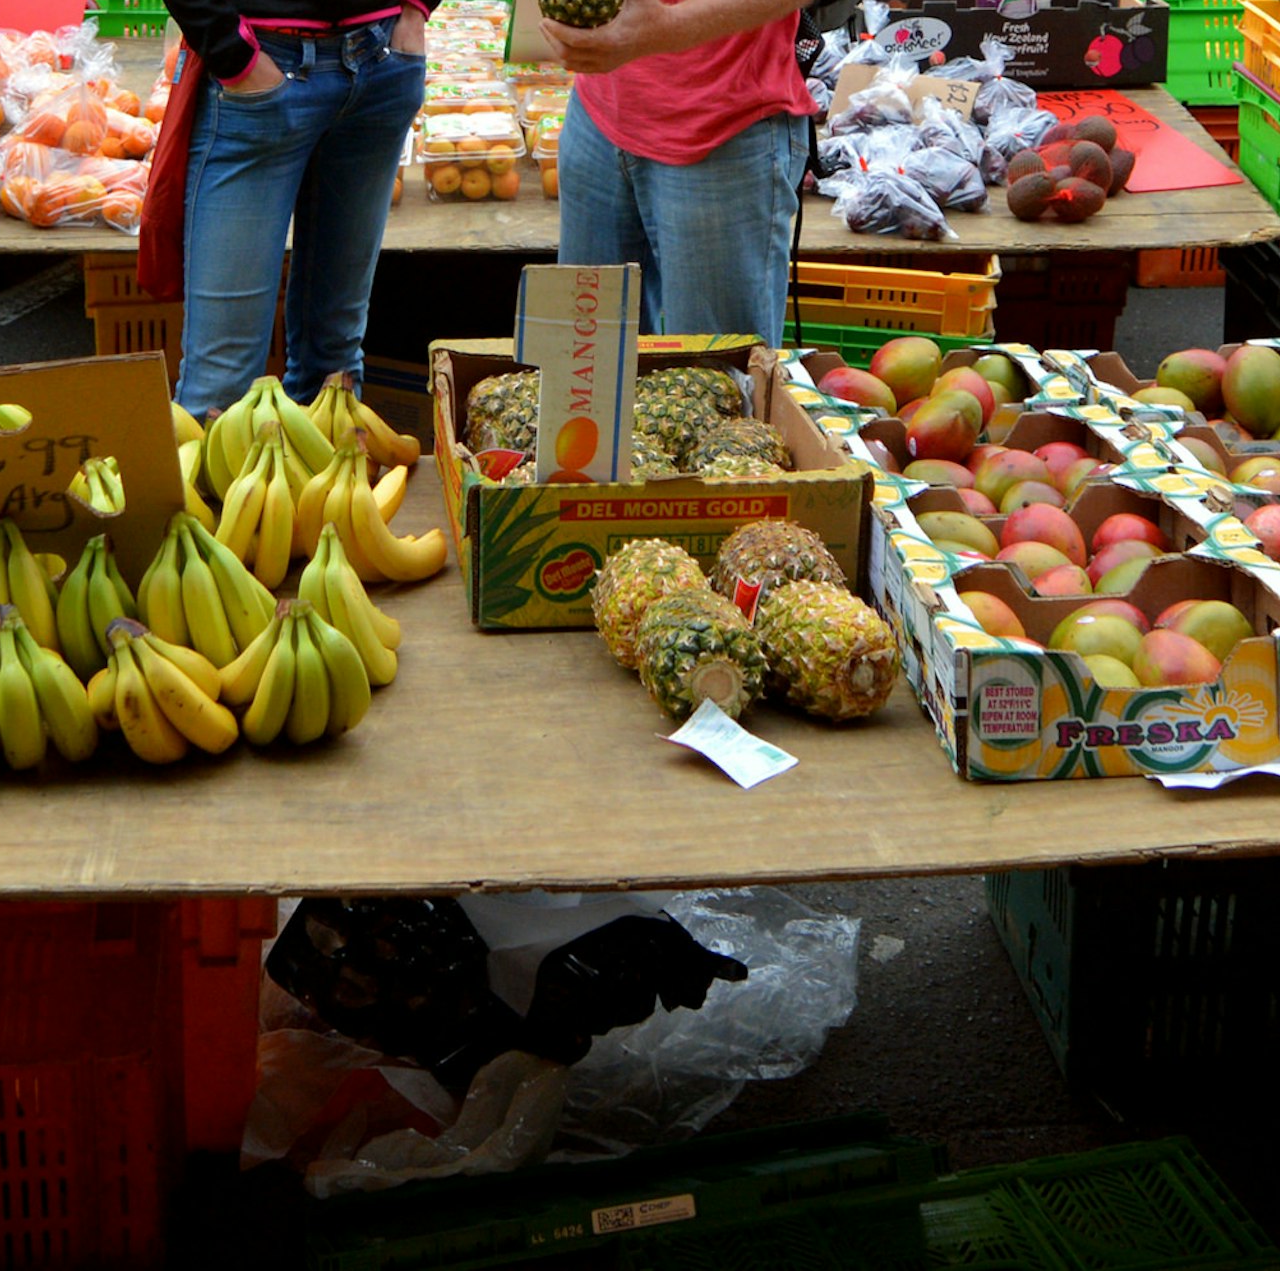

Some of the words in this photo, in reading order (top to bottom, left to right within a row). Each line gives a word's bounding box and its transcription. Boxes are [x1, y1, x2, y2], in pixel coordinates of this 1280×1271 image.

[1002, 21, 1031, 33] Fresh
[1009, 31, 1050, 45] Zealand
[577, 502, 615, 519] DEL
[623, 500, 699, 518] MONTE
[706, 499, 764, 516] GOLD
[985, 686, 1003, 698] BEST
[1005, 686, 1035, 698] STORED
[987, 699, 997, 710] AT
[982, 711, 1003, 722] RIPEN
[1004, 711, 1013, 721] AT
[1014, 710, 1037, 721] ROOM
[984, 723, 1035, 735] TEMPERATURE
[1056, 718, 1235, 748] FRESKA
[1152, 744, 1184, 754] MANGOS
